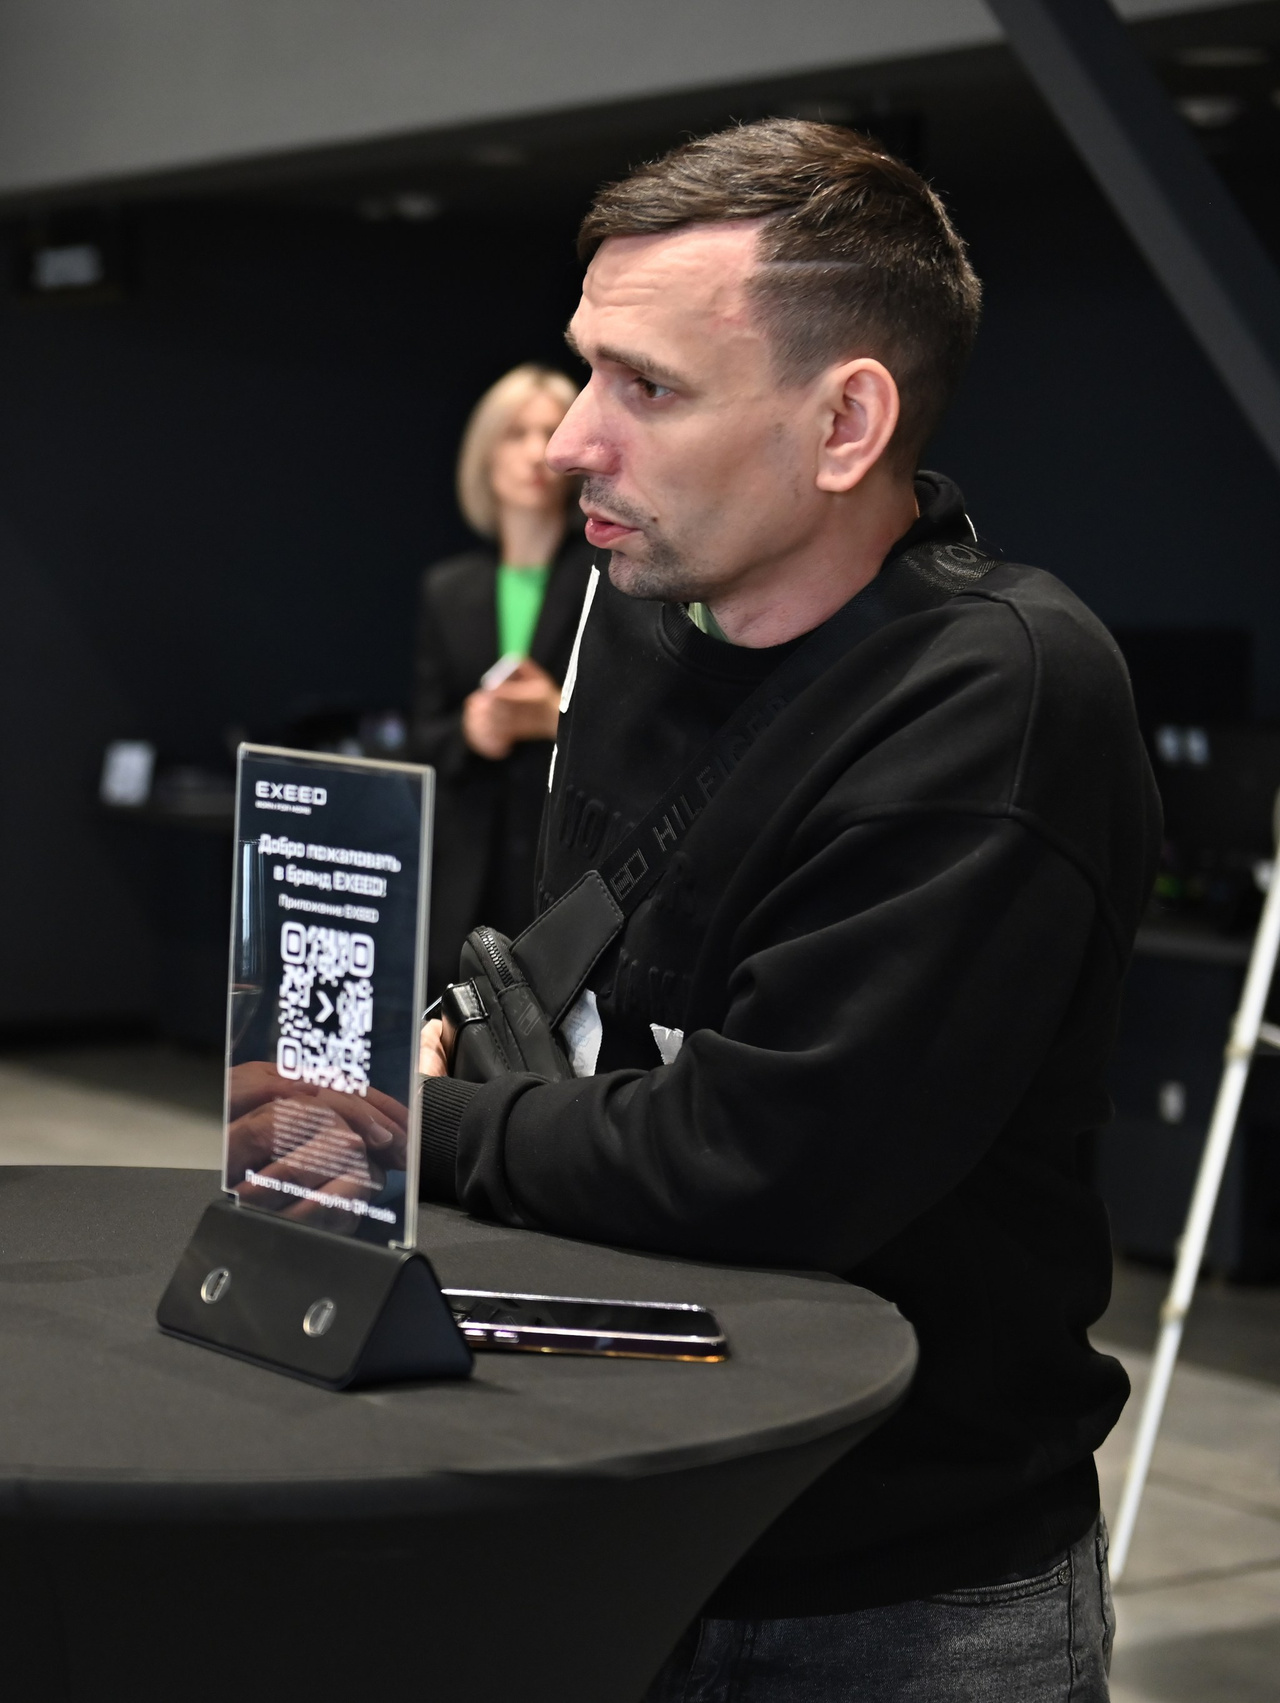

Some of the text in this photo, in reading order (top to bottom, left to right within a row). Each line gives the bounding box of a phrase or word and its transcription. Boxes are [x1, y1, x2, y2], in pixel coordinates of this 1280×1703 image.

[255, 780, 328, 806] EXEED
[258, 833, 402, 873] Добро пожаловать
[273, 865, 285, 881] в
[278, 893, 380, 924] Приложение EXEED
[245, 1169, 282, 1192] Просто
